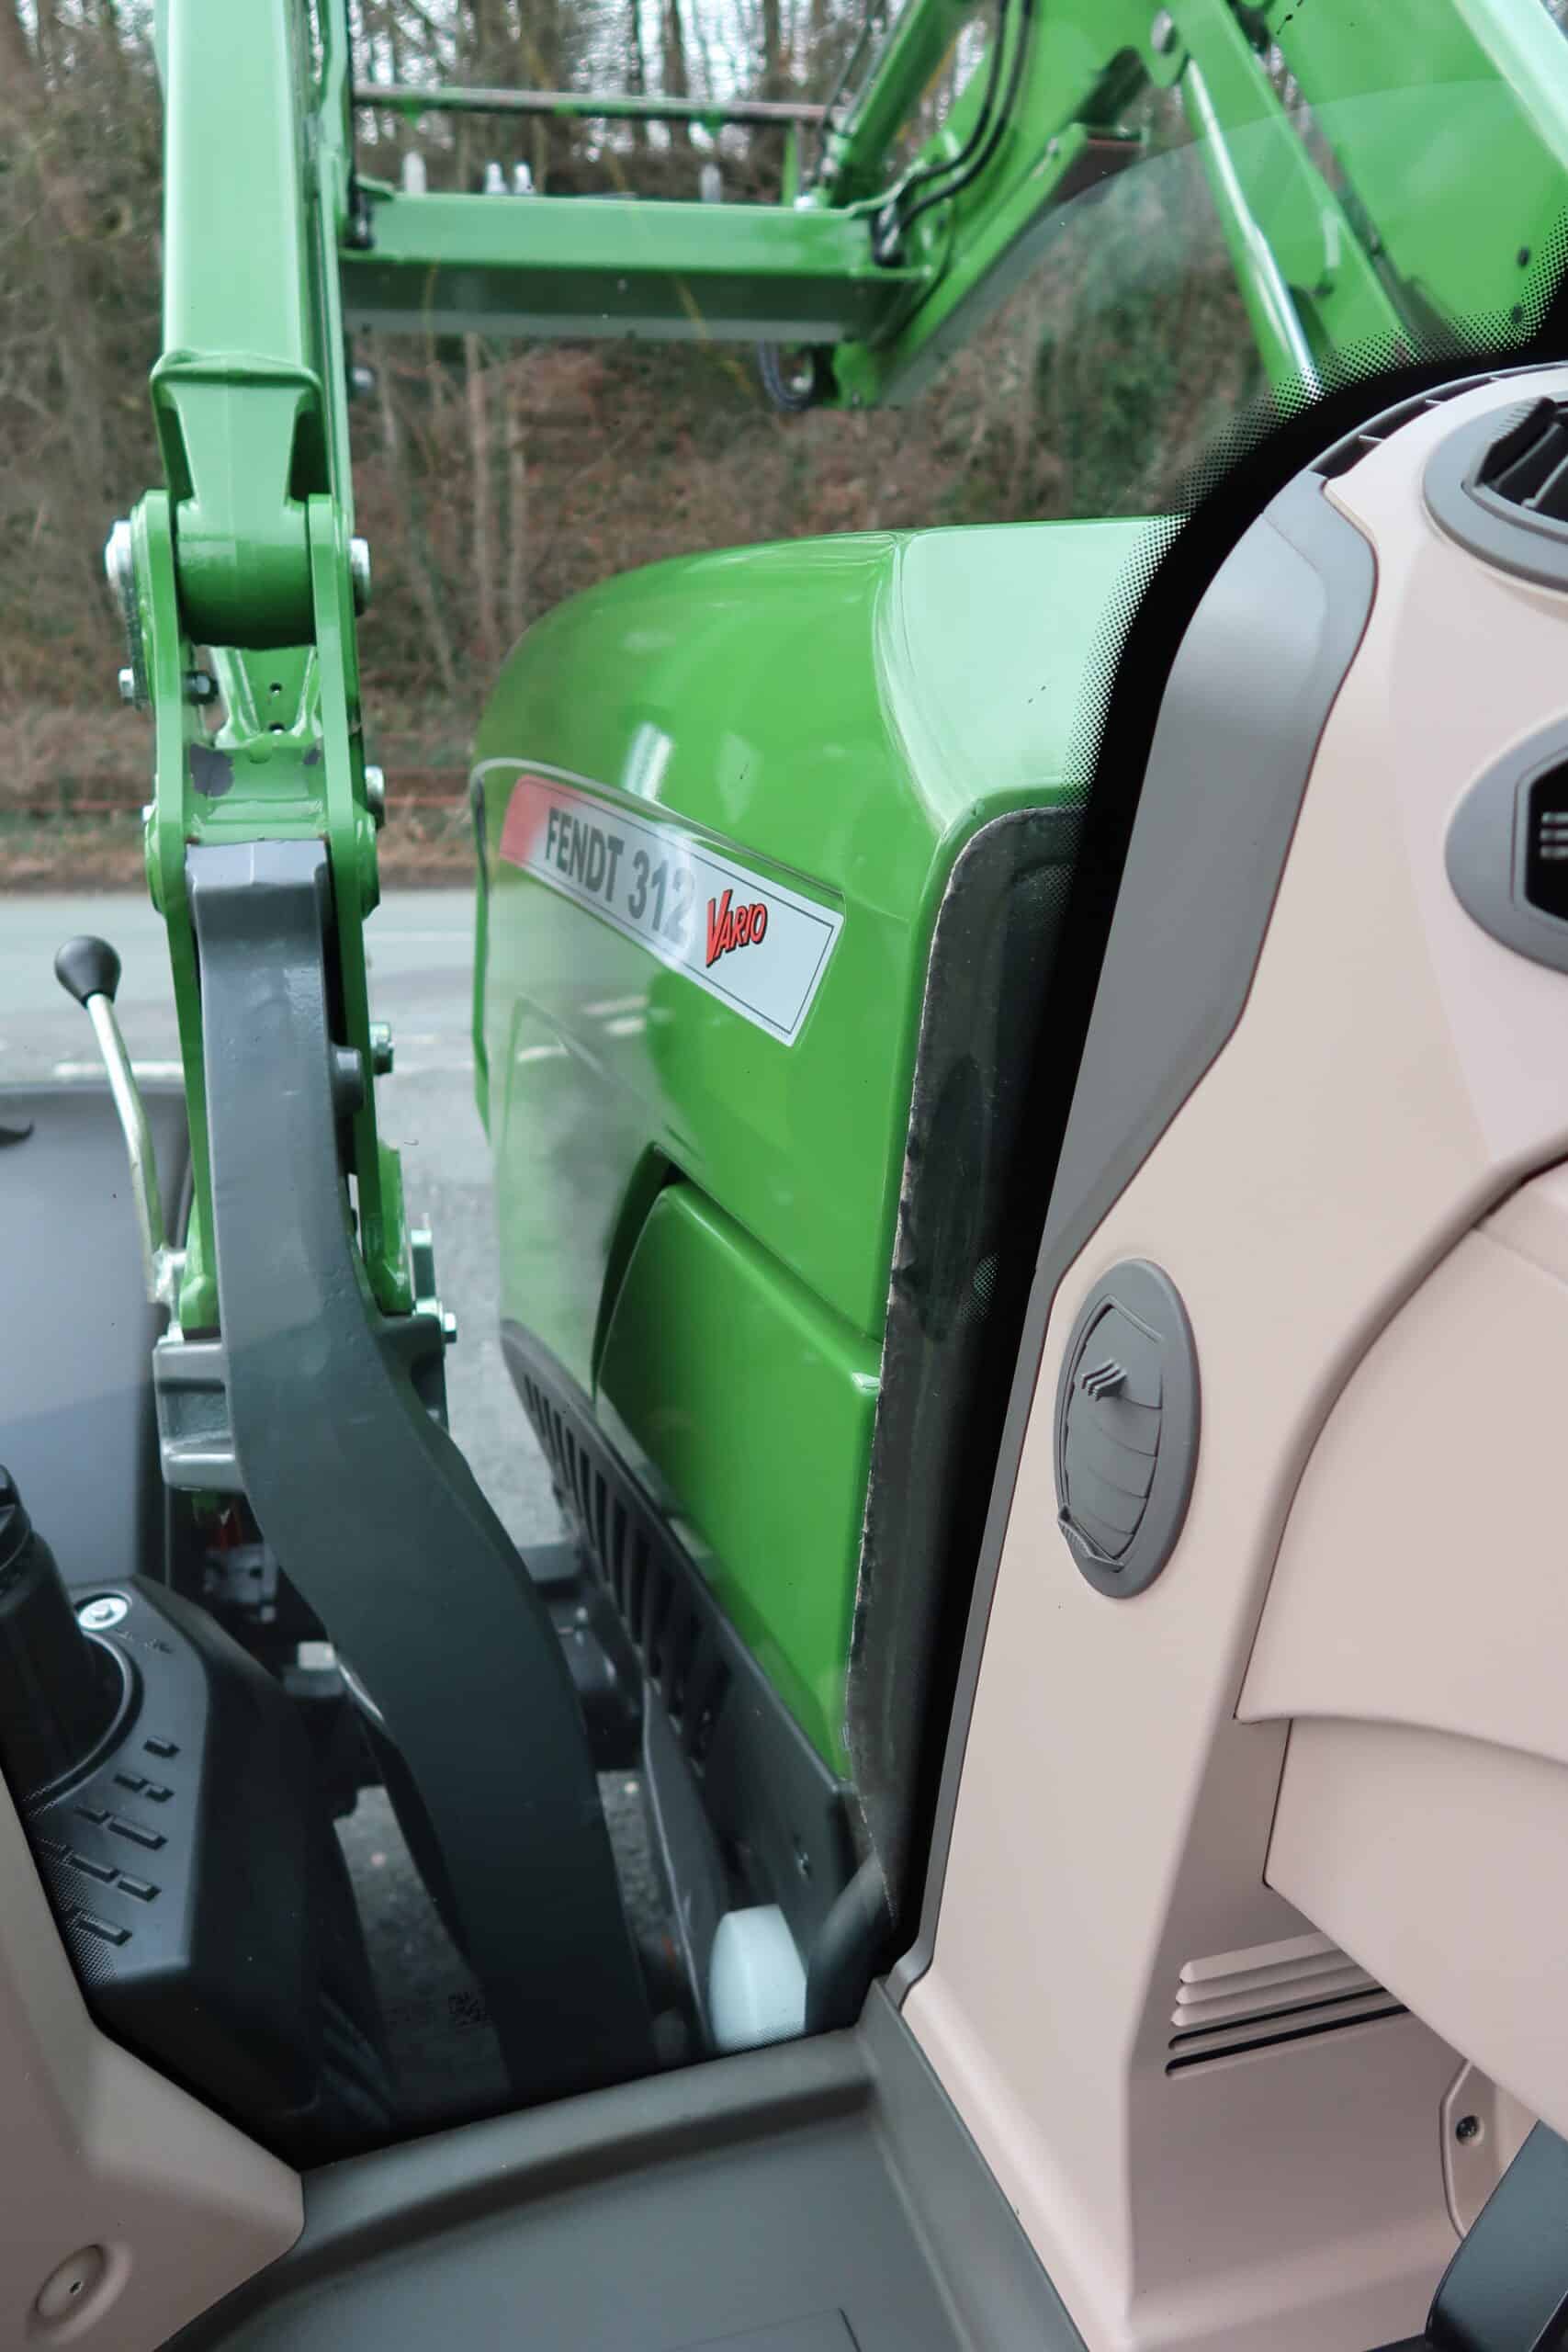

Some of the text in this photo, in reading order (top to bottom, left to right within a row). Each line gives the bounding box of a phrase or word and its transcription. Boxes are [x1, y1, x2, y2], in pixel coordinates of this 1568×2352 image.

[546, 808, 768, 967] FENDT 312 VARIO
